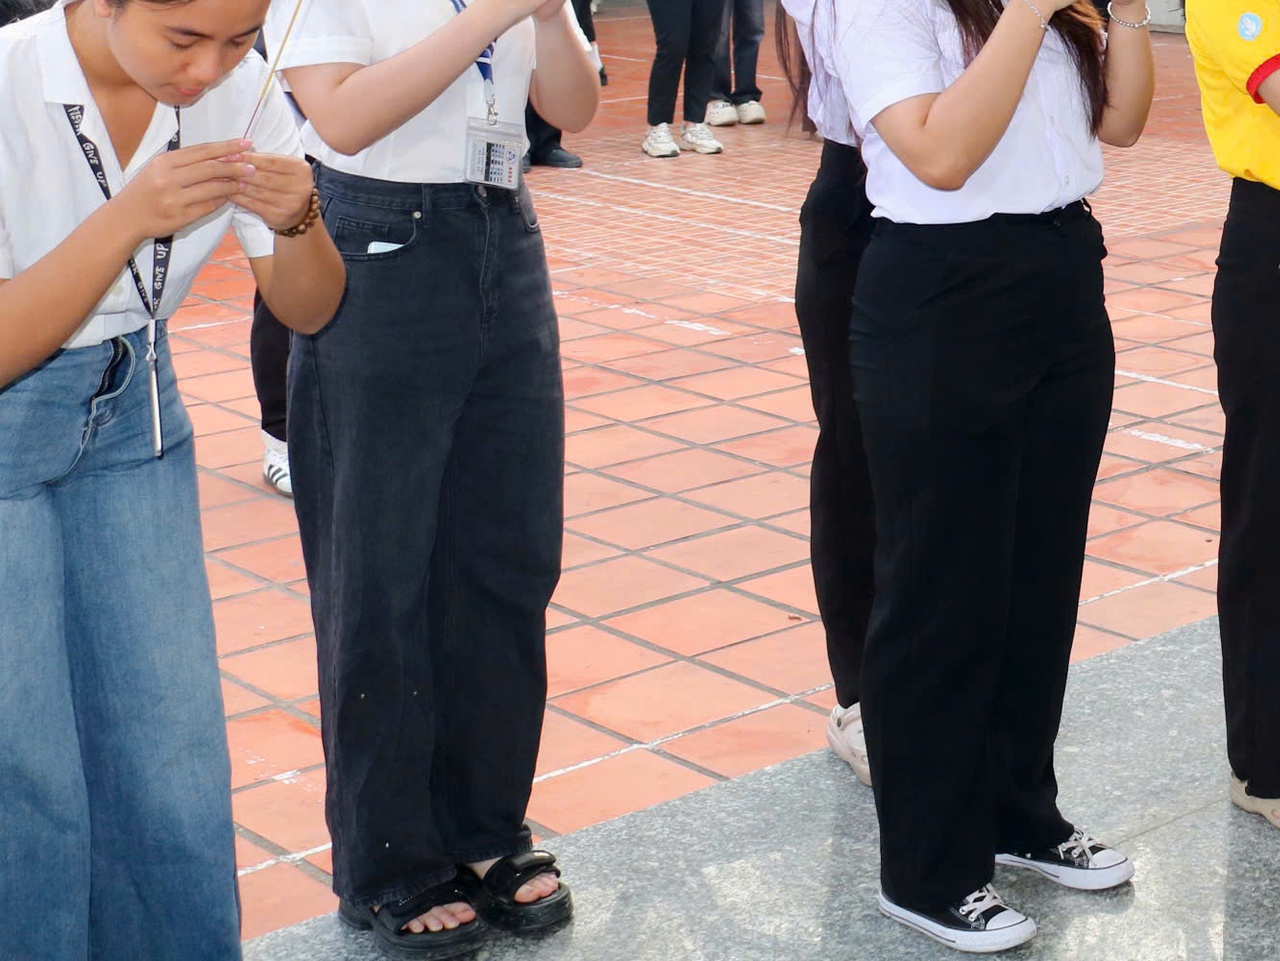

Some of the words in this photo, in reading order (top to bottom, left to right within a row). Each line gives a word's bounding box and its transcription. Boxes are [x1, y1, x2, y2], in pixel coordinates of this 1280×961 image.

[82, 142, 99, 166] GIVE
[96, 171, 107, 188] UP
[155, 243, 169, 259] UP
[154, 266, 165, 290] GIVE
